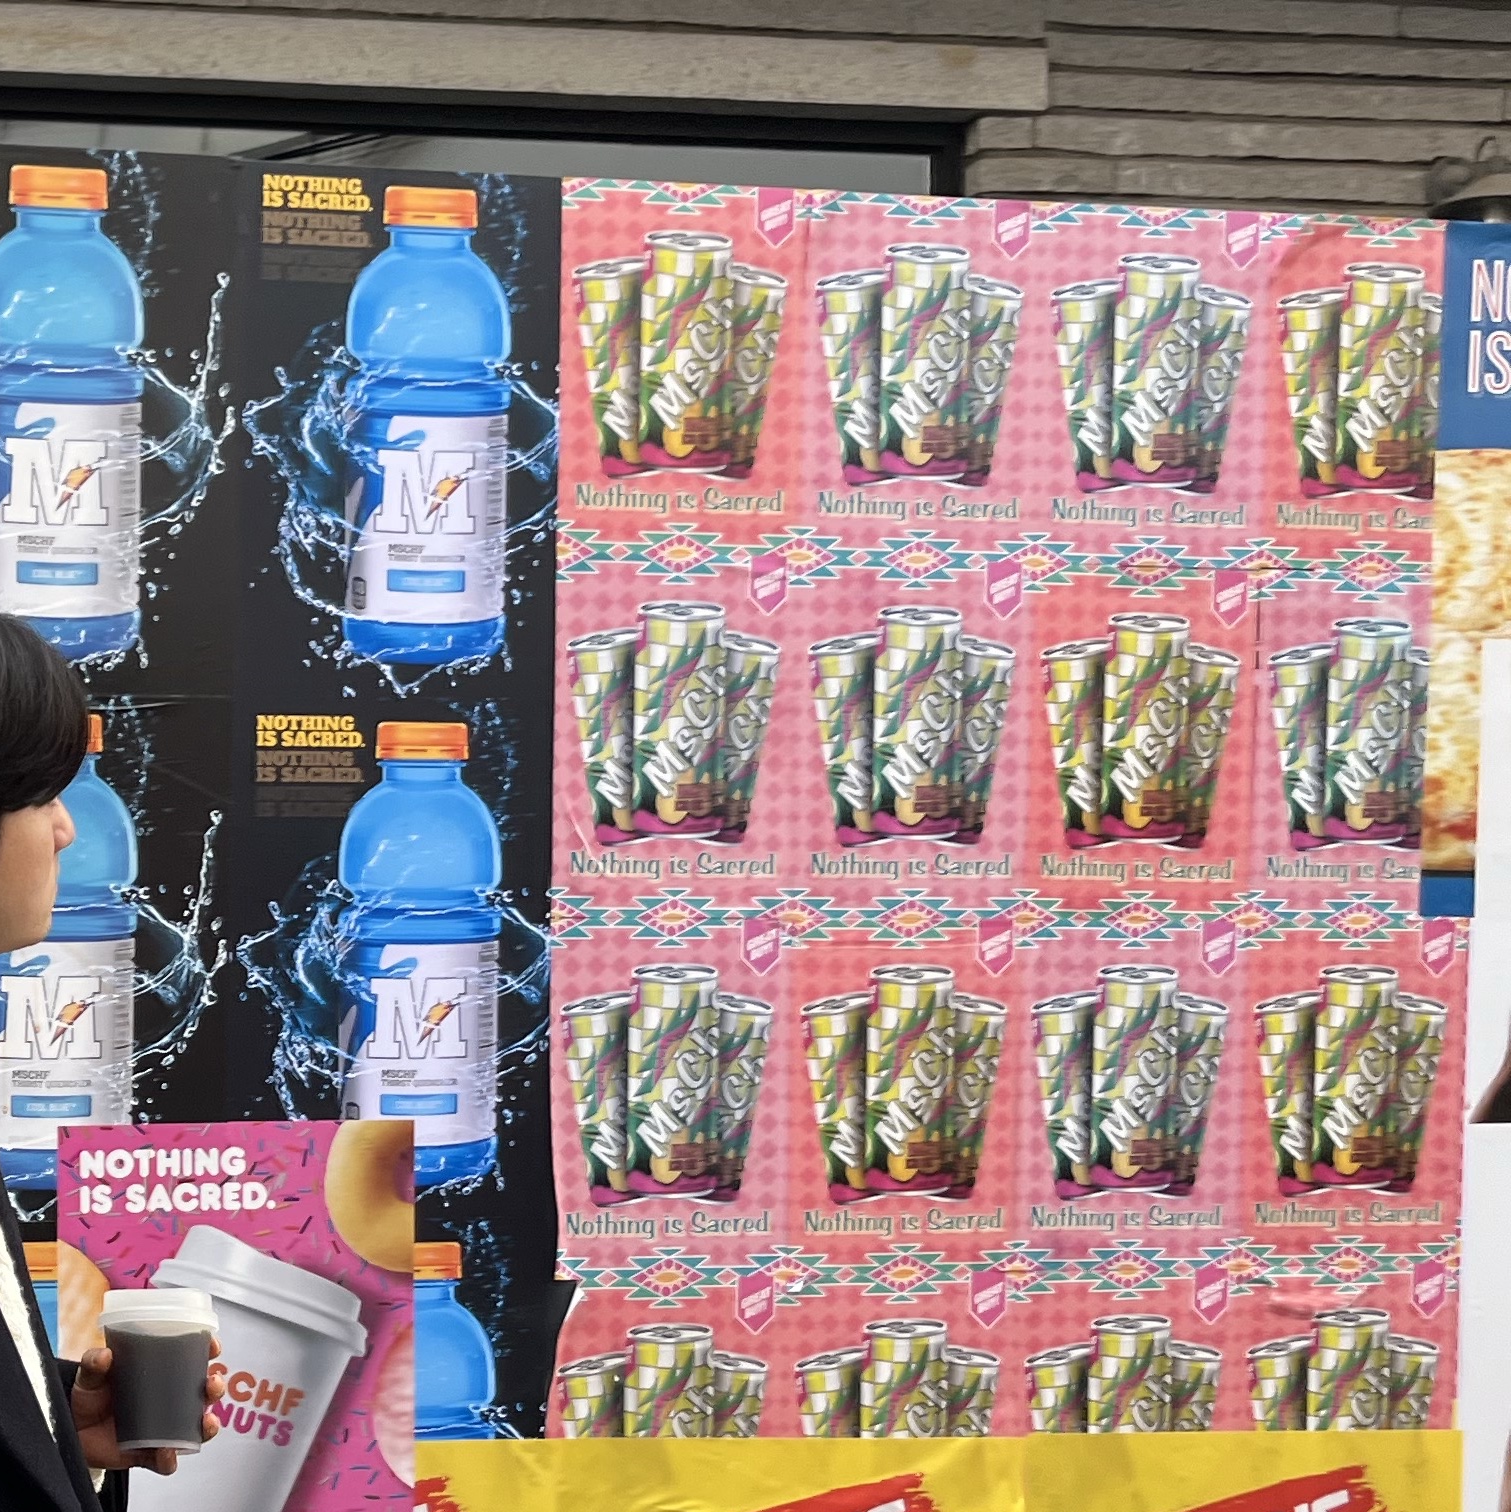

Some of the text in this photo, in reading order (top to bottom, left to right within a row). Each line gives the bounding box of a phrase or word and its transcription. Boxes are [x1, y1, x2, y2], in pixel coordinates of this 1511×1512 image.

[262, 173, 362, 194] NOTHING
[262, 191, 373, 212] IS SACRED.
[1467, 330, 1511, 395] IS
[576, 484, 783, 513] Nothing is Sacred
[818, 491, 1018, 520] Nothing is Sacred
[1051, 498, 1246, 527] Nothing is Sacred
[1368, 509, 1385, 529] is
[255, 714, 355, 733] NOTHING
[255, 731, 367, 748] IS SACRED.
[569, 851, 776, 879] Nothing is Sacred
[810, 853, 1013, 880] Nothing is Sacred
[1040, 855, 1234, 881] Nothing is Sacred
[1357, 859, 1374, 879] is
[79, 1146, 246, 1179] NOTHING
[79, 1181, 277, 1214] IS SACRED.
[565, 1210, 769, 1238] Nothing is Sacred
[805, 1208, 1003, 1236] Nothing is Sacred
[1030, 1205, 1223, 1231] Nothing is Sacred
[1345, 1203, 1362, 1224] is
